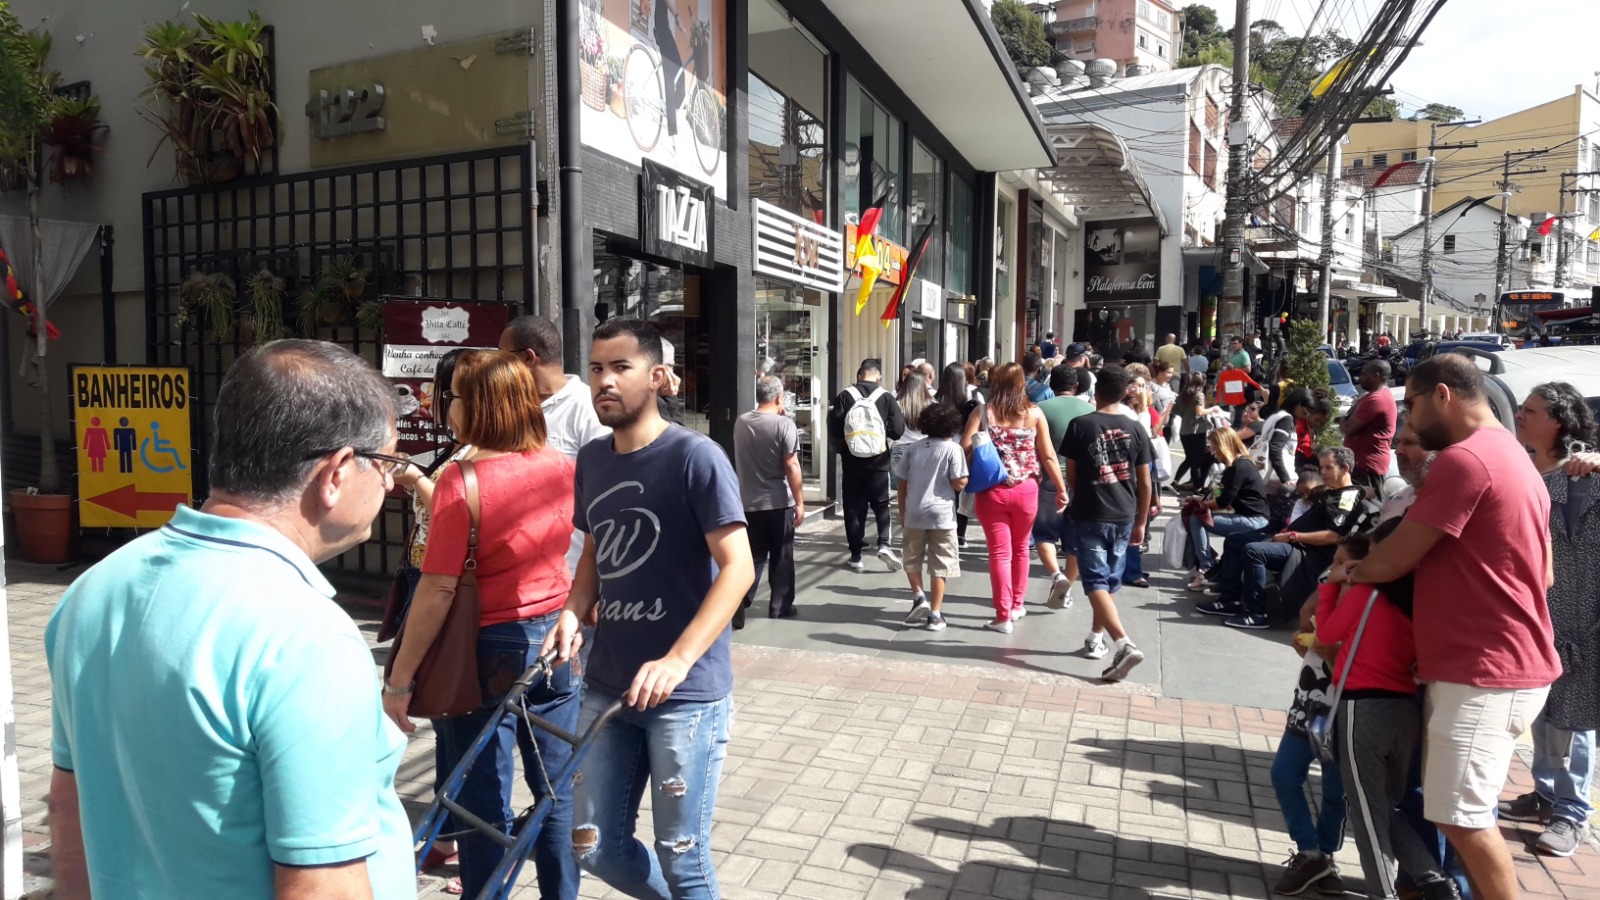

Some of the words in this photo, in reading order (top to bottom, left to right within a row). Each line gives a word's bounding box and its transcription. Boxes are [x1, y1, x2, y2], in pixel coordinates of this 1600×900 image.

[657, 184, 708, 253] TAZZA
[426, 320, 444, 329] Villa
[400, 364, 422, 375] Café
[423, 364, 435, 373] da
[77, 373, 186, 409] BANHEIROS
[395, 420, 412, 428] afés
